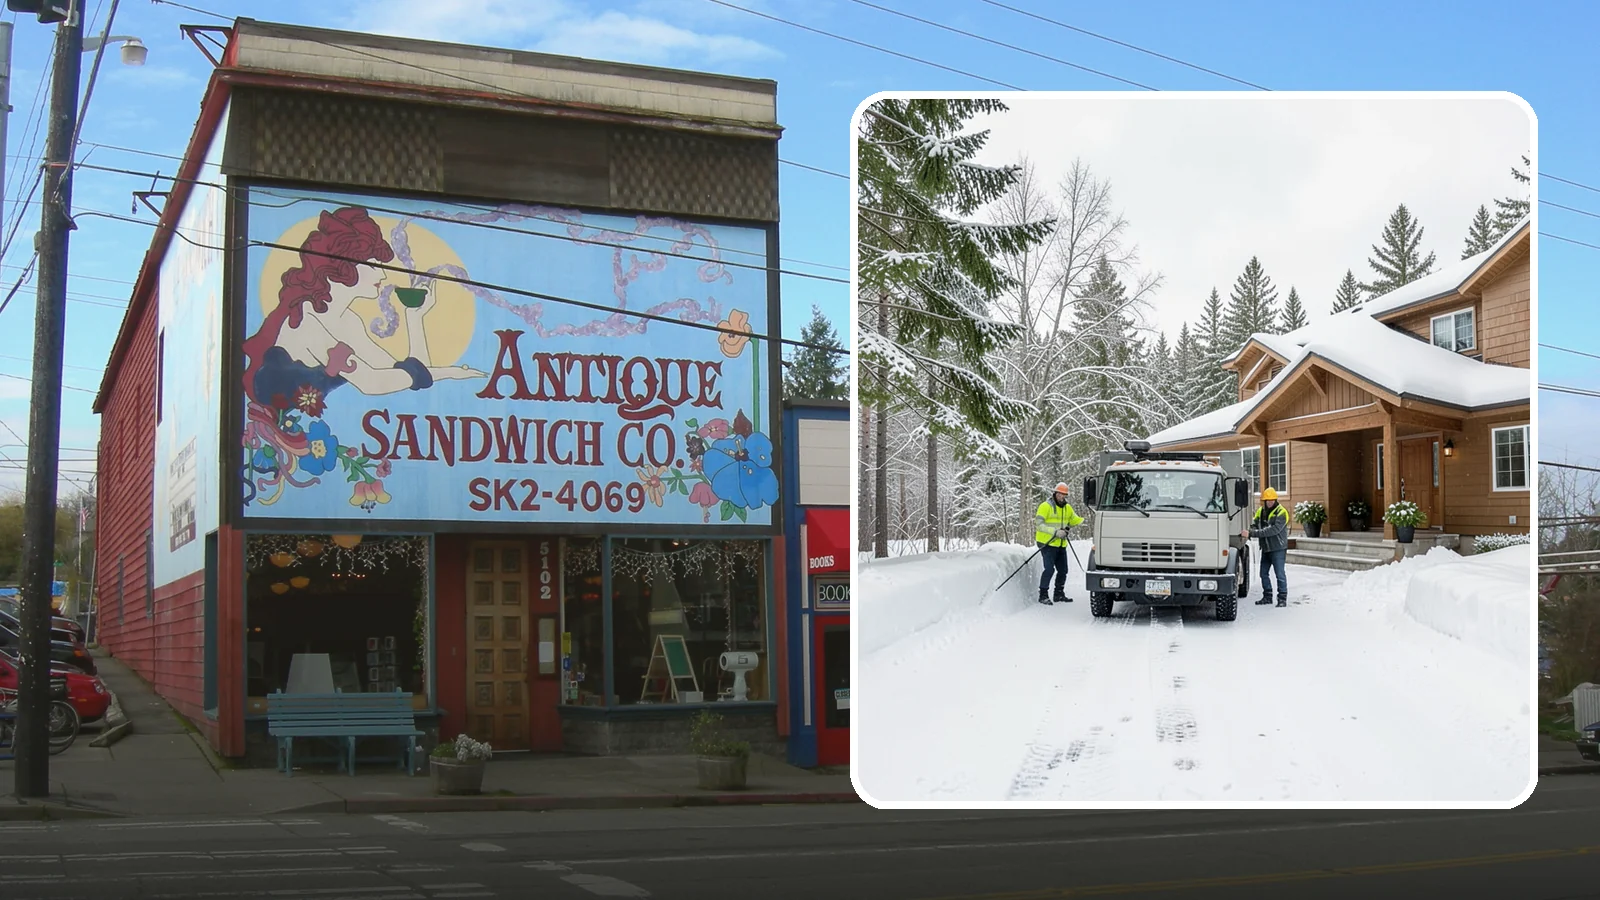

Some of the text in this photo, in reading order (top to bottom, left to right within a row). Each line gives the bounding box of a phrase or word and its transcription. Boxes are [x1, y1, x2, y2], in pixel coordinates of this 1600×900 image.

[475, 329, 724, 421] ANTIQUE
[360, 408, 685, 469] SANDWICH CO.
[468, 477, 646, 513] SK2-4069
[540, 542, 552, 599] 5102
[809, 555, 835, 569] BOOKS
